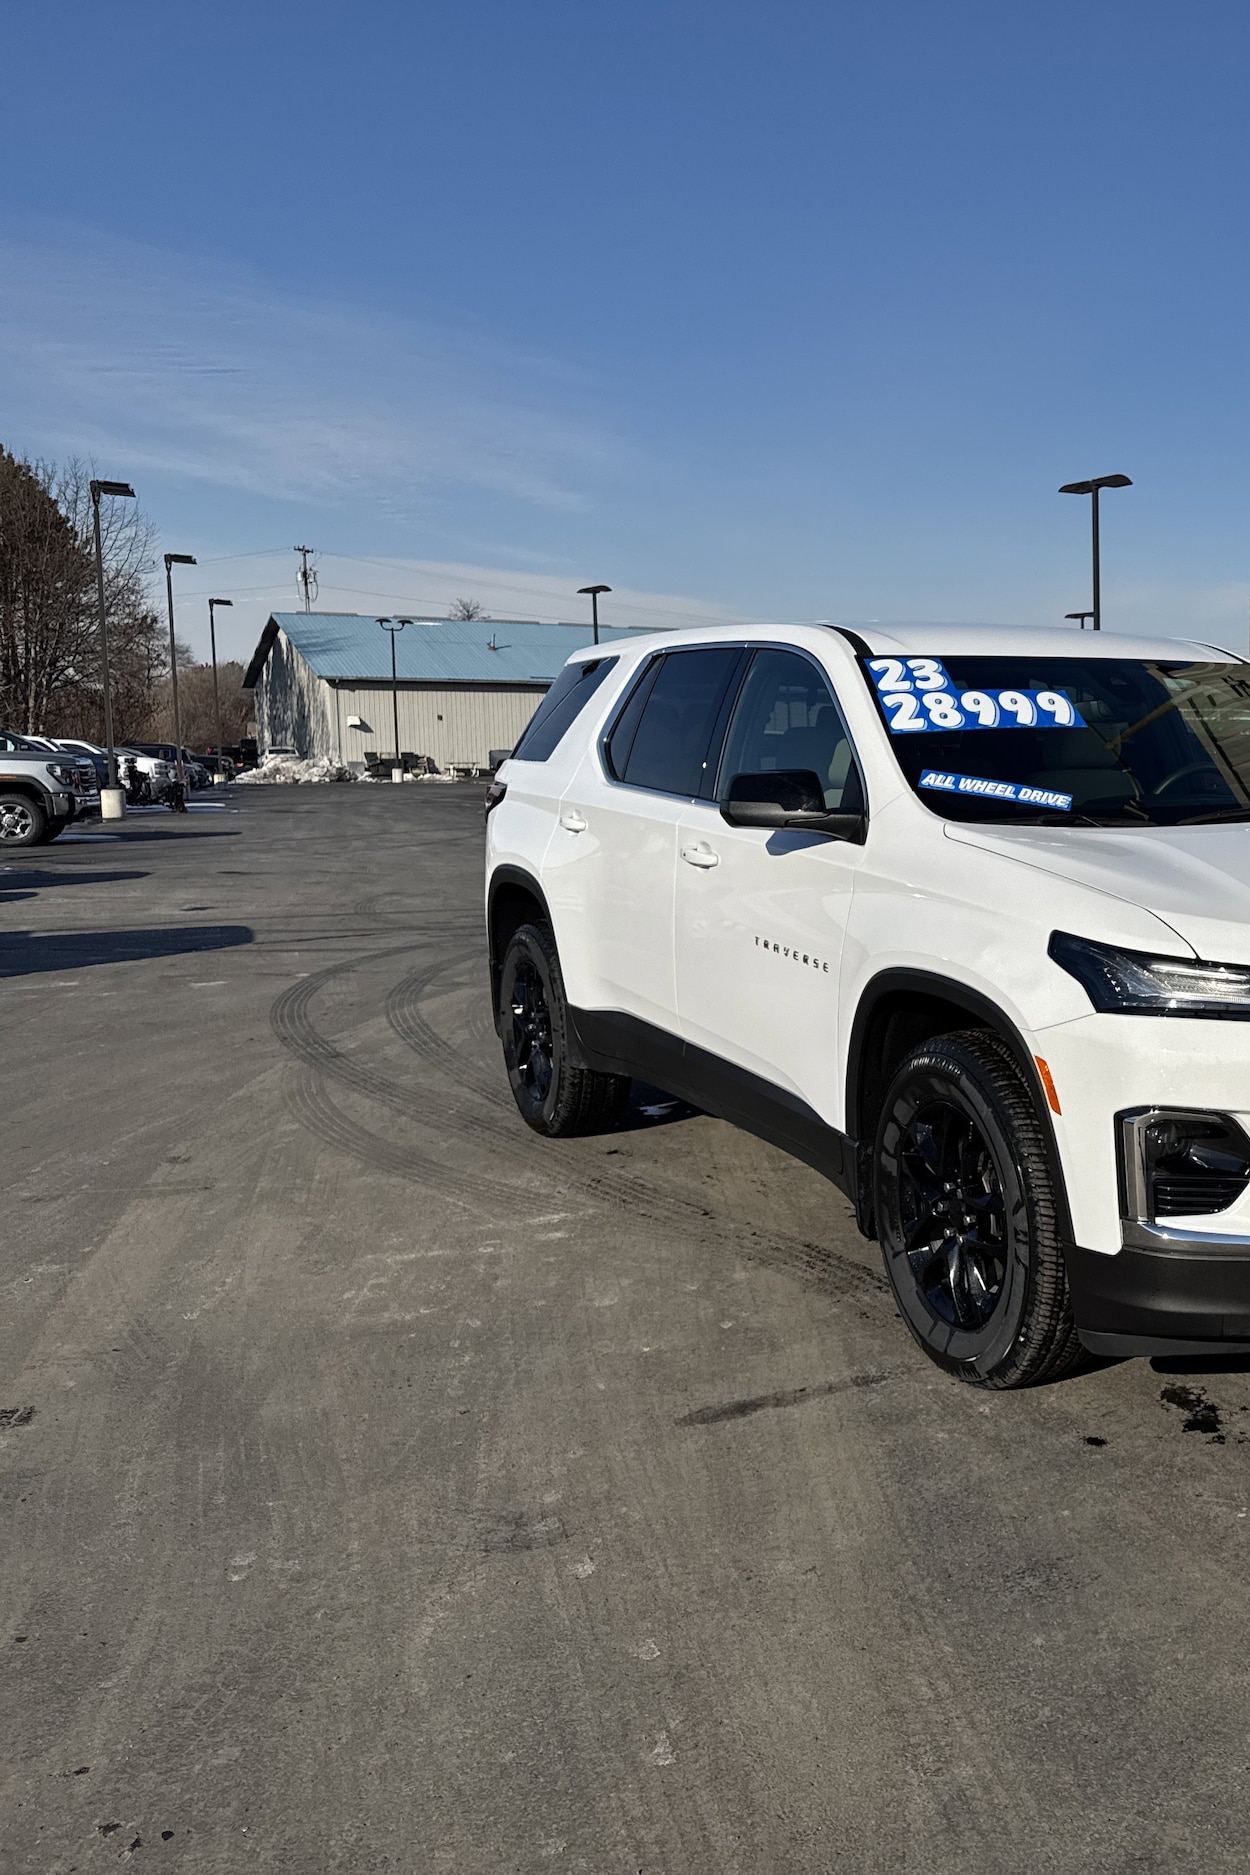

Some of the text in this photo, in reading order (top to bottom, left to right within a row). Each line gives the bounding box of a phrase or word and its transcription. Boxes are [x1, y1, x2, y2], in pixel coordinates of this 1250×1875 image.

[869, 658, 948, 692] 23
[882, 691, 1075, 731] 28999
[921, 772, 1073, 809] ALL WHEEL DRIVE
[754, 935, 830, 974] TRAVERSE
